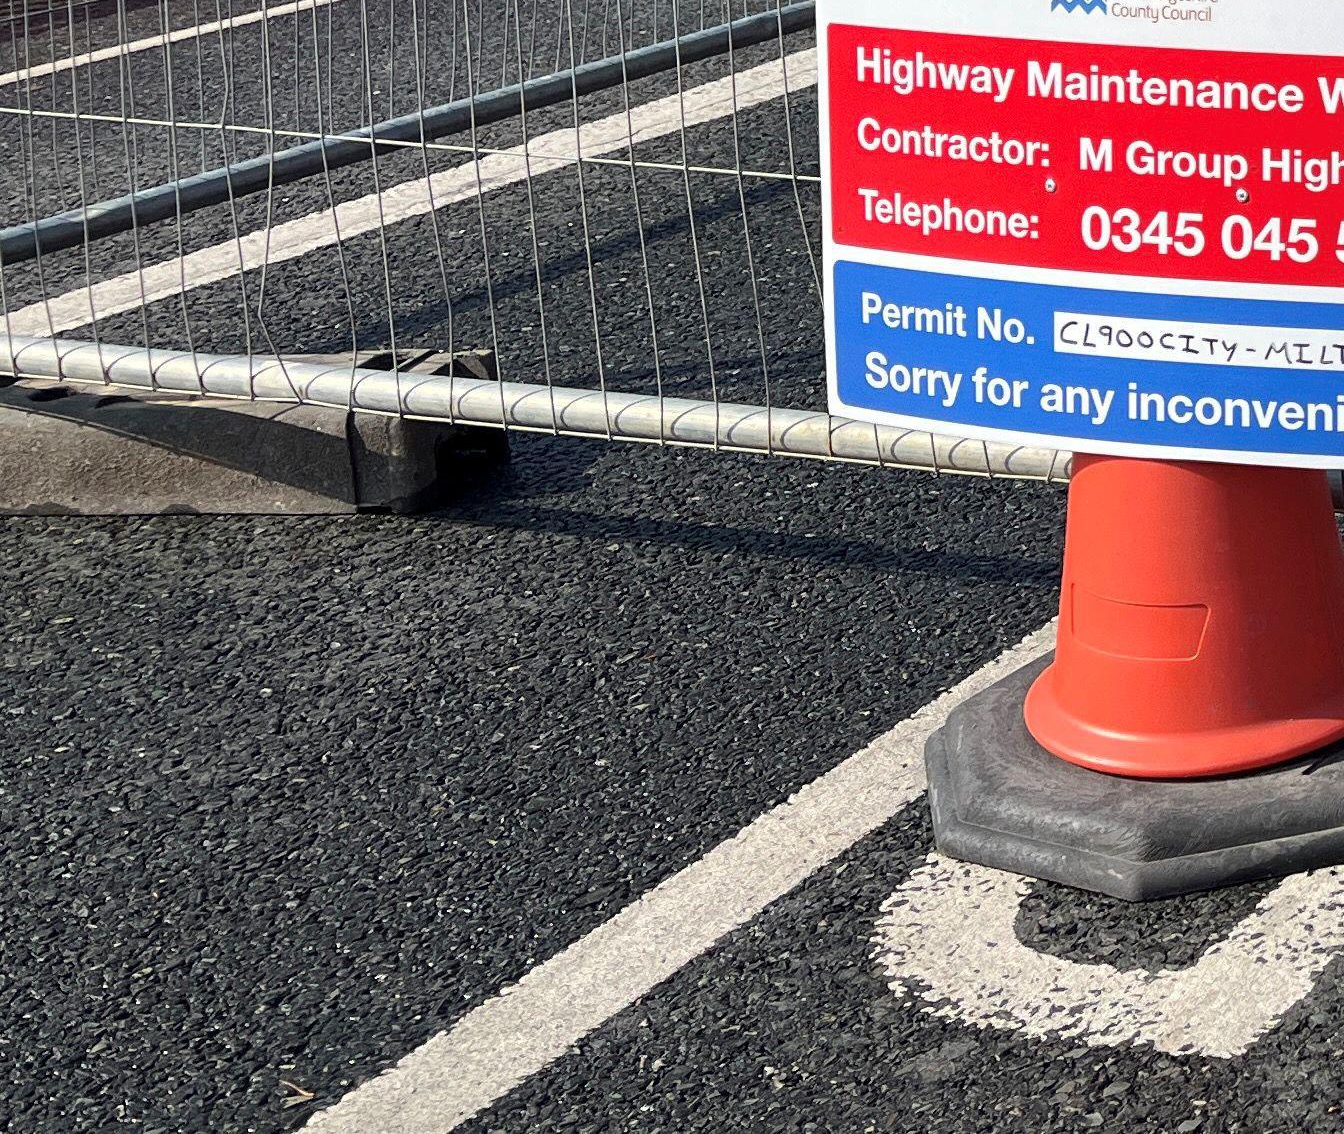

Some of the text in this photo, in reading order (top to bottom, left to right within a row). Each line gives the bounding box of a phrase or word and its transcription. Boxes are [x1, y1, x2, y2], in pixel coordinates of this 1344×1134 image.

[1112, 3, 1211, 23] County Council
[857, 47, 1014, 102] Highway
[1028, 61, 1303, 112] Maintenance
[858, 118, 1049, 166] Contractor:
[1080, 138, 1112, 171] M
[1126, 141, 1247, 186] Group
[858, 188, 1038, 238] Telephone:
[1082, 206, 1204, 256] 0345
[1222, 215, 1318, 262] 045
[862, 292, 1034, 344] Permit No.
[866, 352, 962, 407] Sorry
[972, 367, 1028, 407] for
[1041, 384, 1114, 424] any
